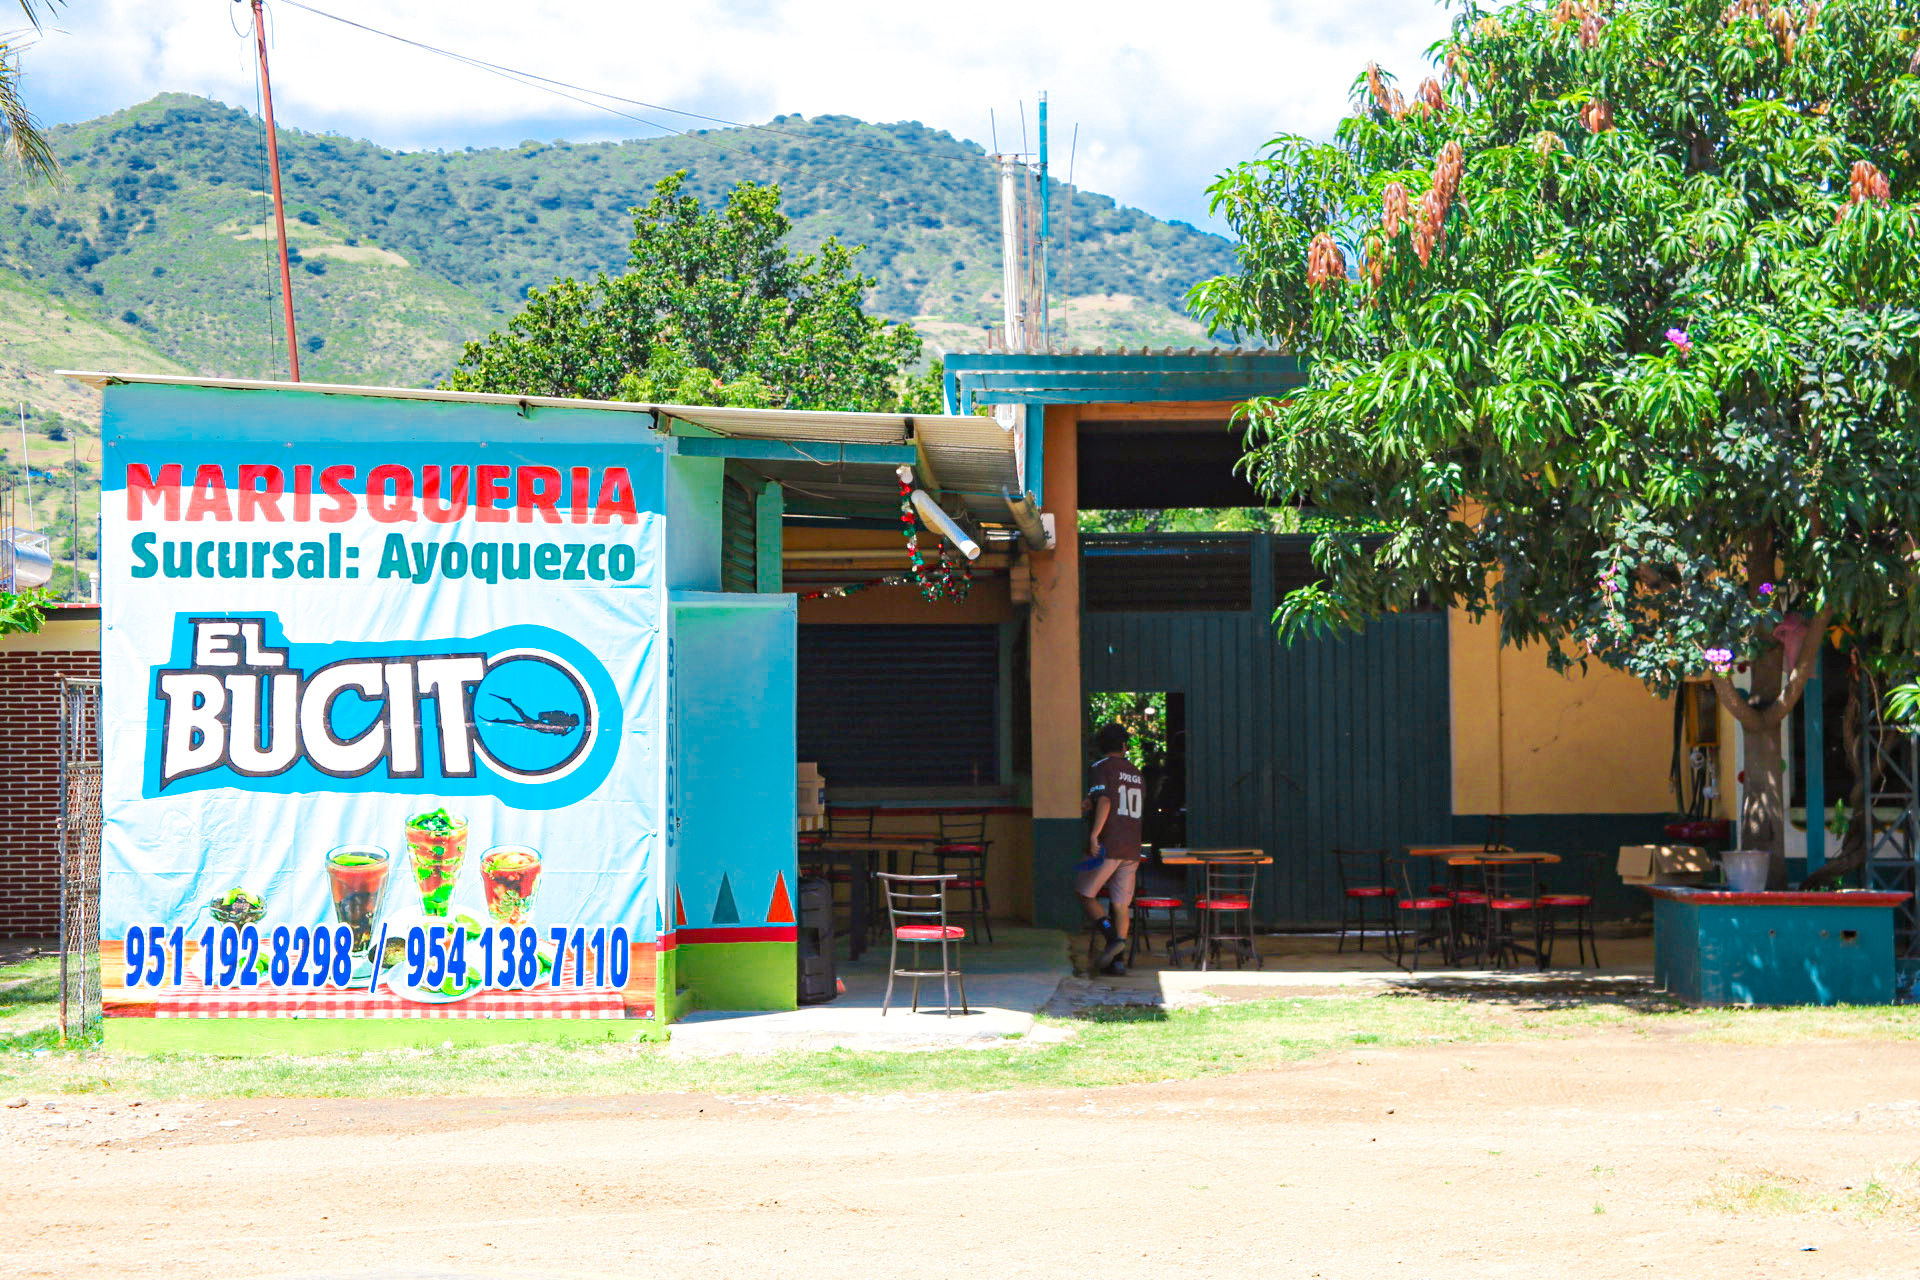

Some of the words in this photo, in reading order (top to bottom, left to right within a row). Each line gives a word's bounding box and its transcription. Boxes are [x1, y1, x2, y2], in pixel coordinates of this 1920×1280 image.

[126, 463, 639, 525] MARISQUERIA
[130, 532, 359, 579] Sucursal:
[377, 532, 636, 584] Ayoquezco
[195, 621, 285, 667] EL
[158, 648, 598, 788] BUCITO
[1117, 784, 1143, 819] 10
[126, 925, 183, 987] 951
[200, 925, 259, 987] 192
[270, 925, 353, 988] 8298
[370, 922, 388, 993] /
[406, 926, 466, 987] 954
[479, 926, 538, 988] 138
[550, 927, 630, 988] 7110
